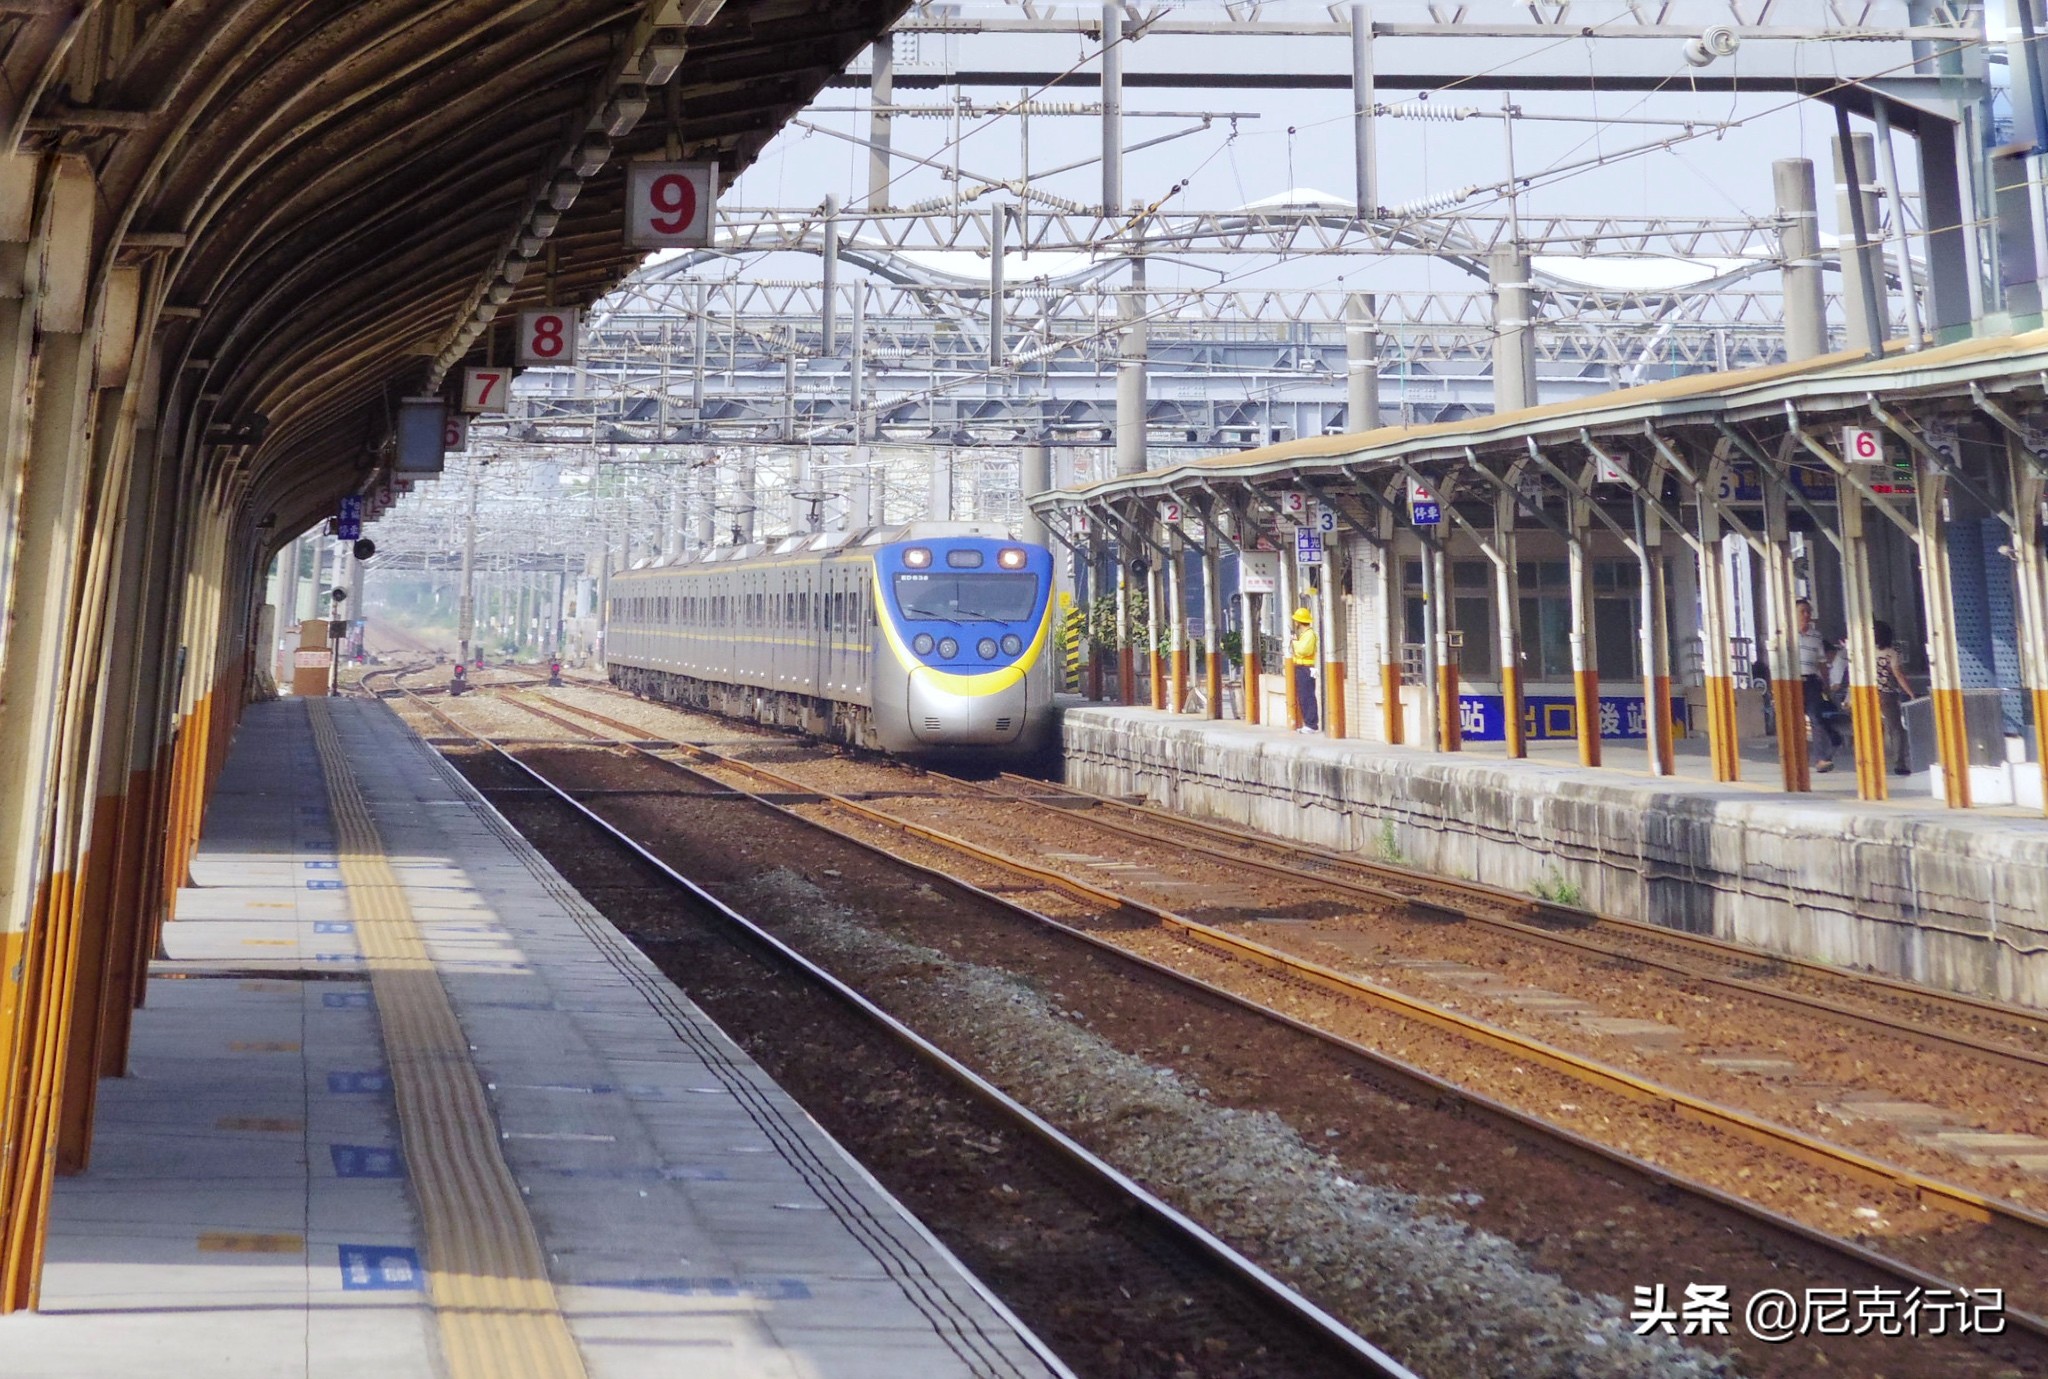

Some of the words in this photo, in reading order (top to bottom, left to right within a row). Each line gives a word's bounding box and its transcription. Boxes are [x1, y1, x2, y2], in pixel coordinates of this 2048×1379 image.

[650, 173, 696, 234] 9
[532, 316, 563, 357] 8
[476, 373, 500, 405] 7
[444, 420, 459, 447] 6
[1856, 432, 1876, 457] 6
[1415, 485, 1428, 499] 4
[1290, 494, 1302, 510] 3
[1168, 505, 1179, 520] 2
[1415, 506, 1439, 520] 停車
[1080, 517, 1086, 530] 1
[1322, 513, 1333, 530] 3
